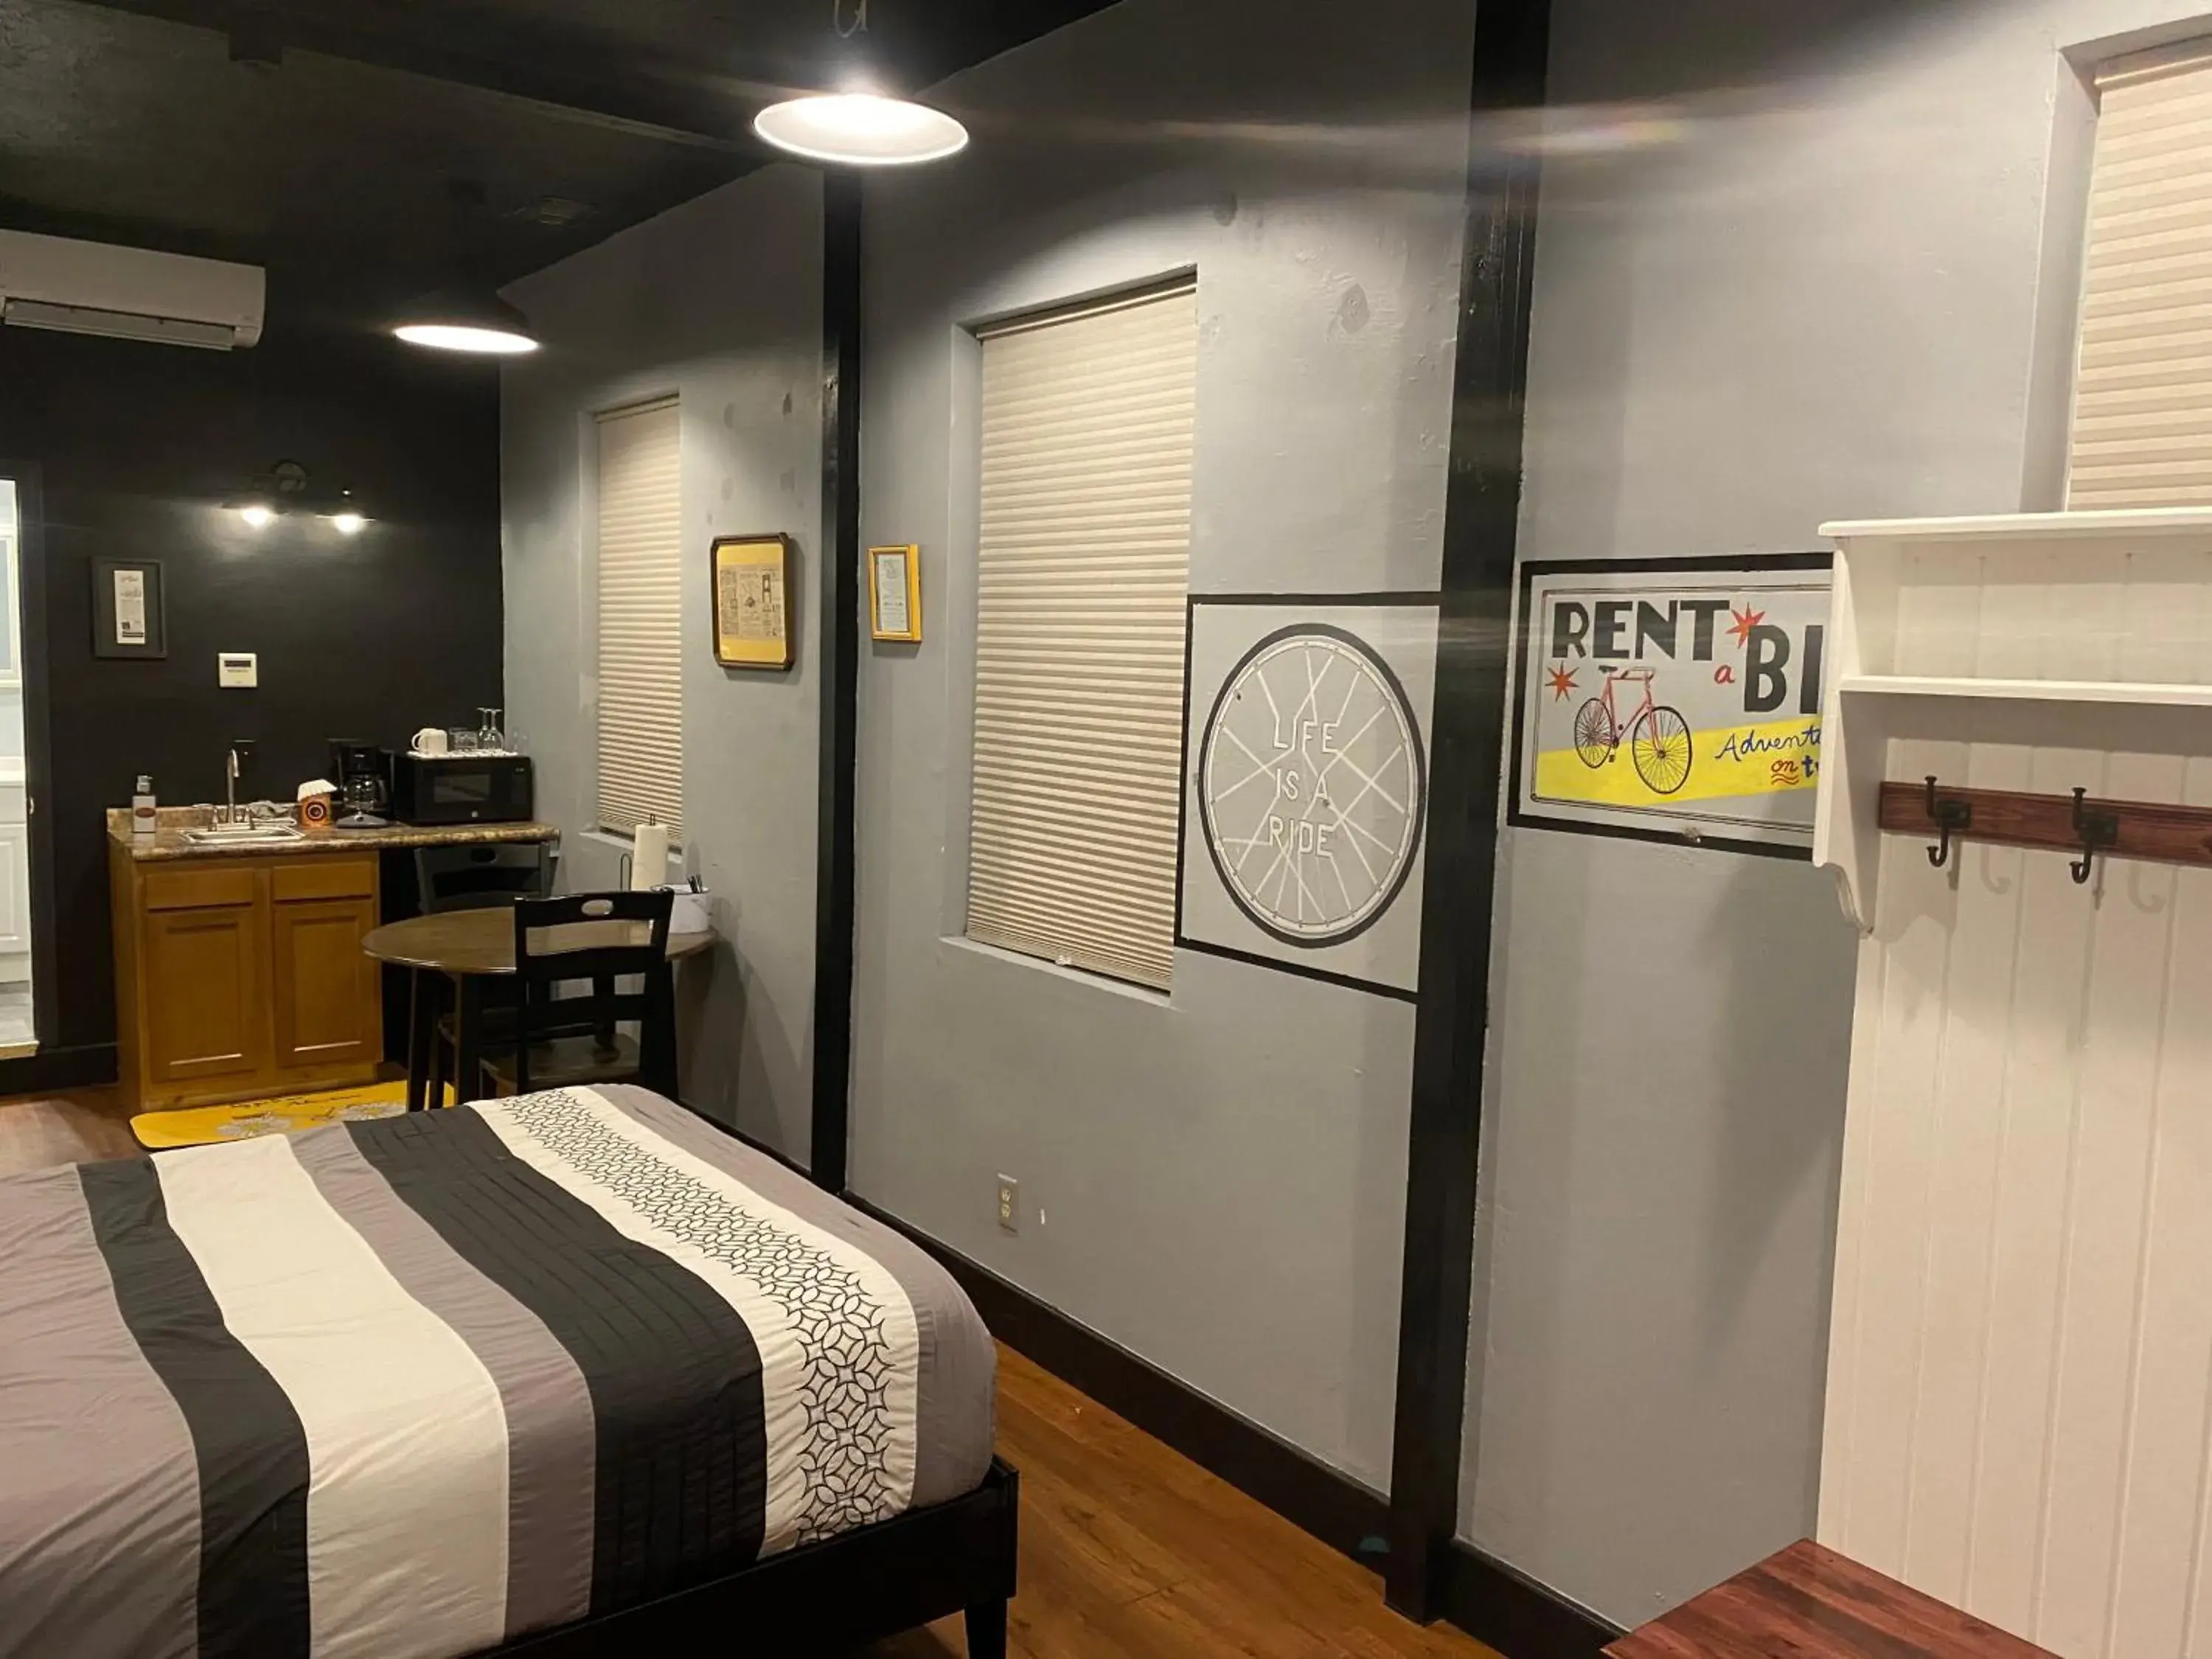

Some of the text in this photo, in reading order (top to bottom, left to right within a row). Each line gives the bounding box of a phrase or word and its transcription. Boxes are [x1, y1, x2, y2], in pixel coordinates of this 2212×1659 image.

[1551, 600, 1823, 714] RENT a BI
[1273, 717, 1340, 753] LIFE
[1274, 768, 1329, 800] IS A
[1771, 759, 1798, 773] on
[1269, 815, 1335, 858] RIDE
